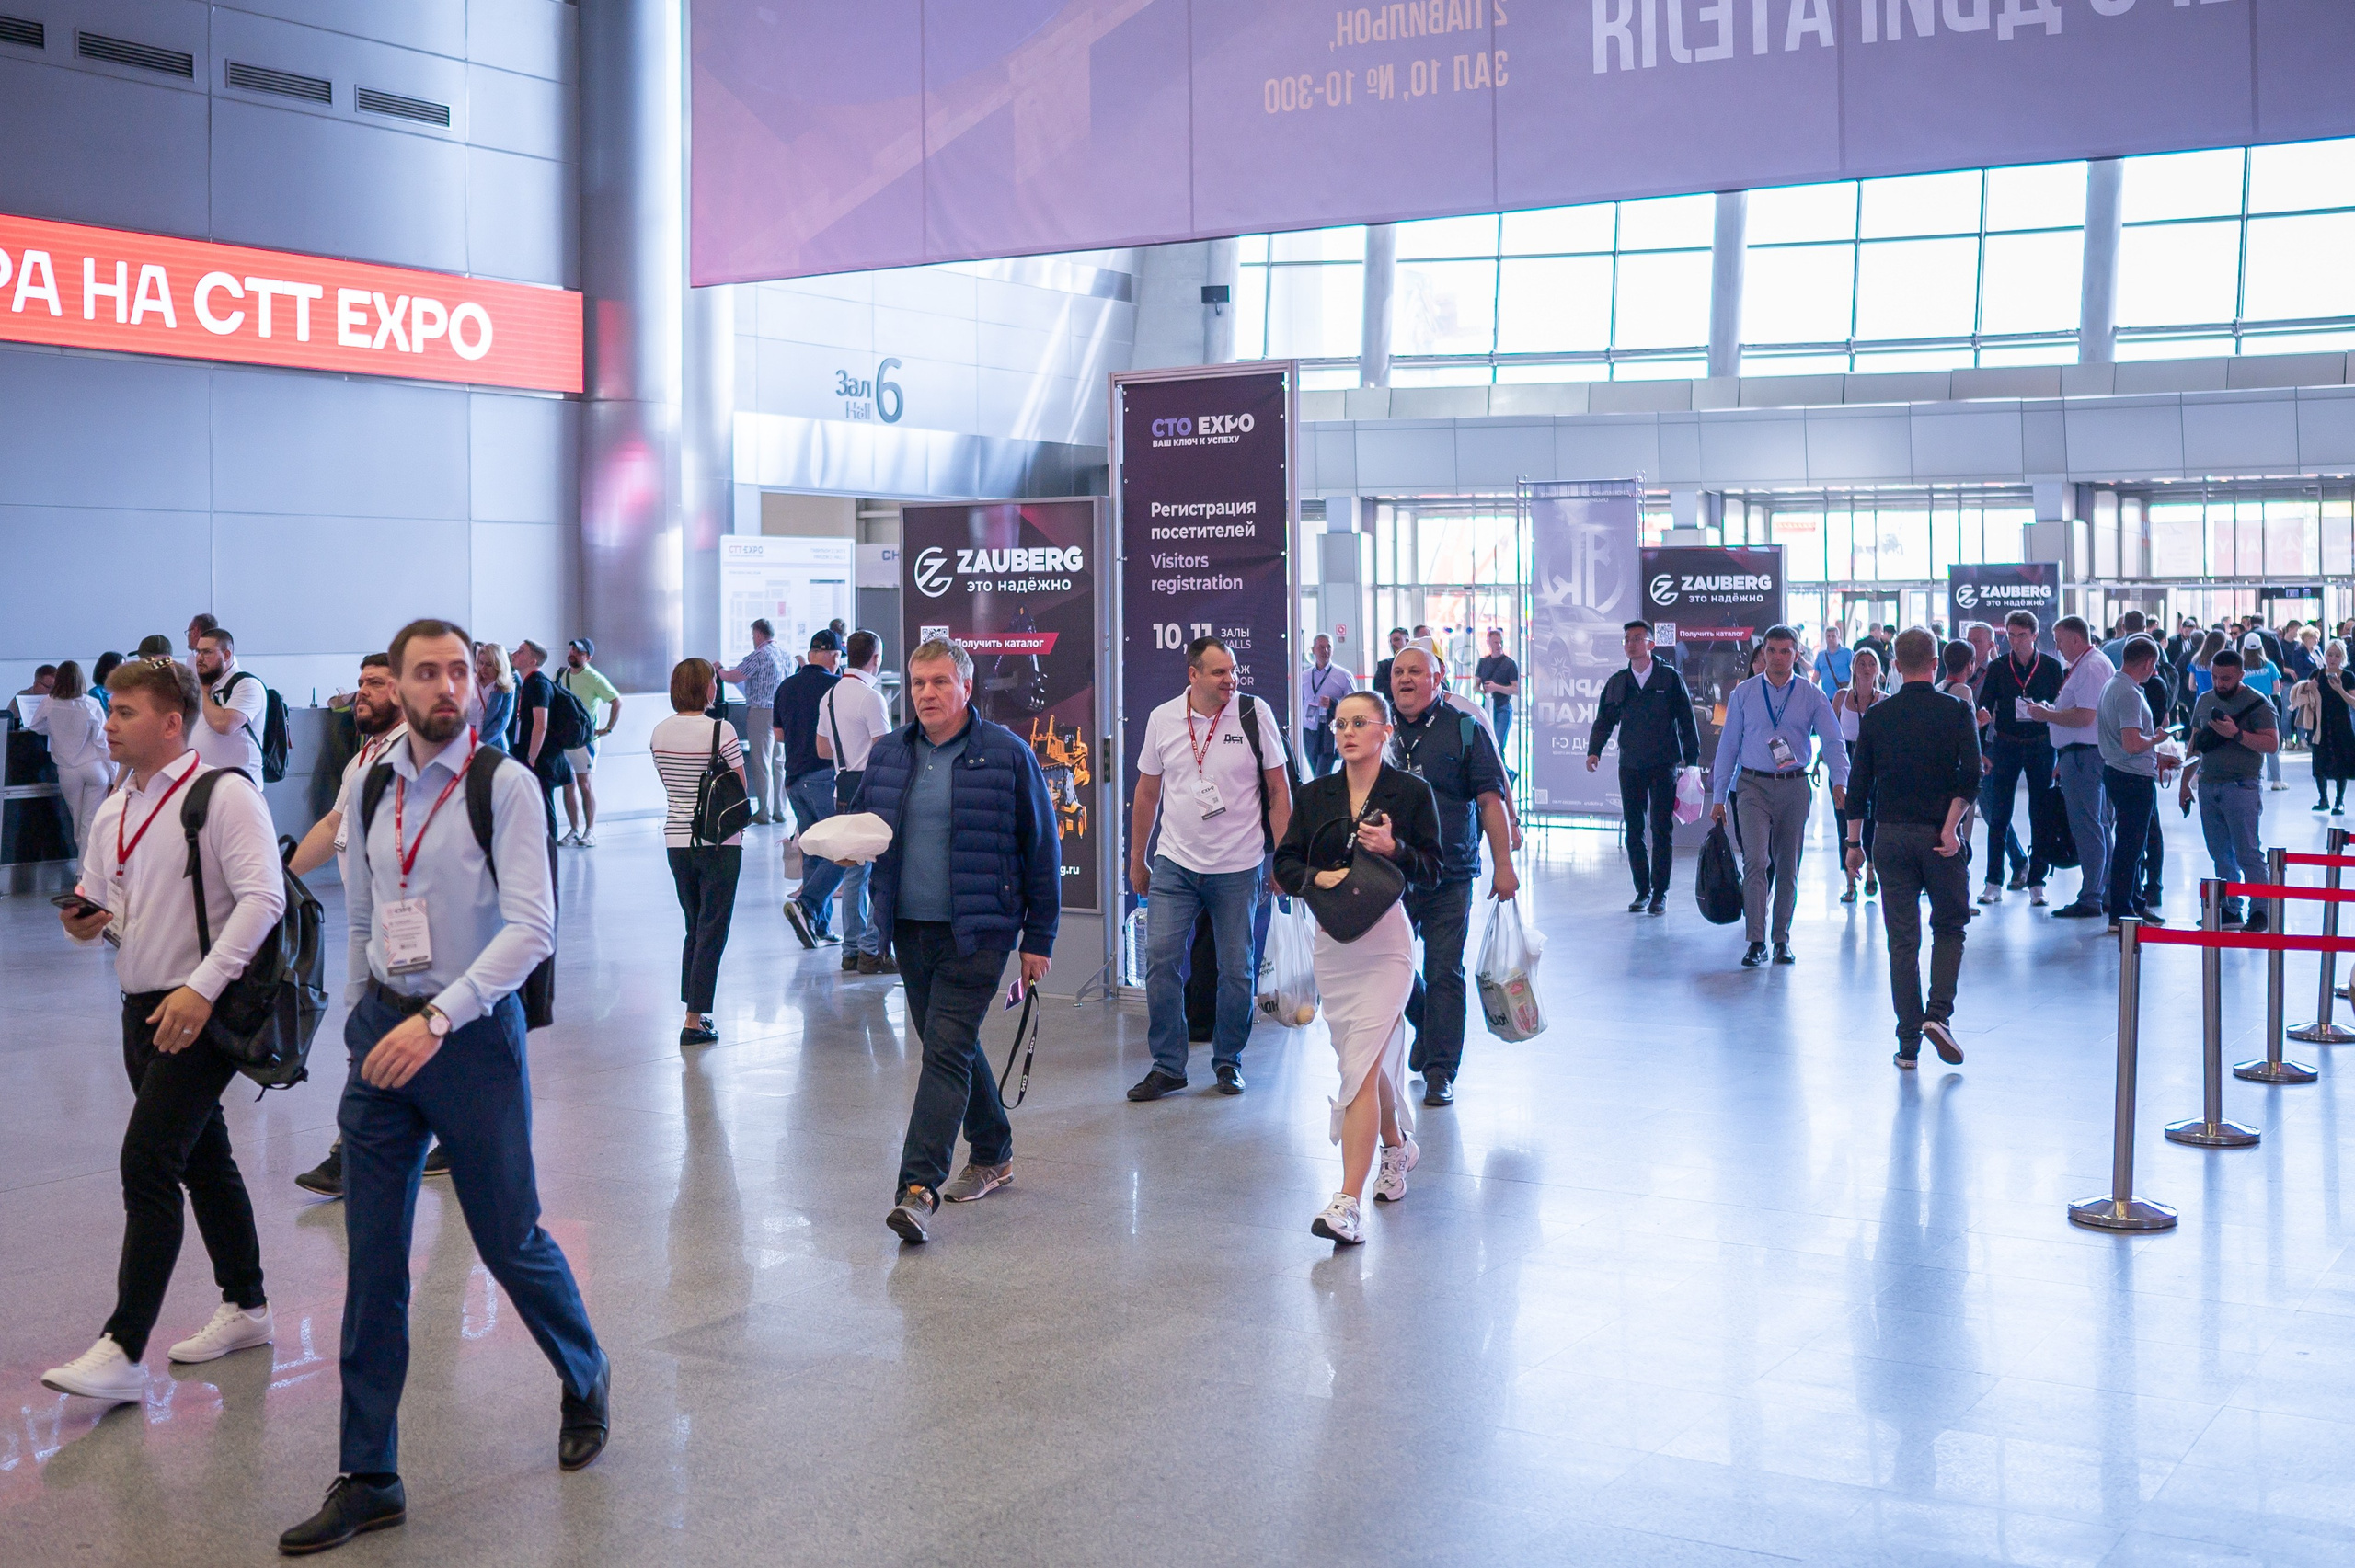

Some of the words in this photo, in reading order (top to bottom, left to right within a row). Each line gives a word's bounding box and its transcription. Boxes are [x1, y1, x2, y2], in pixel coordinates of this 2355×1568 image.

[83, 257, 177, 328] НА
[193, 270, 324, 342] CTT
[337, 287, 493, 361] EXPO
[835, 369, 872, 399] Зал
[876, 357, 904, 424] 6
[845, 400, 872, 420] Hall
[1198, 413, 1255, 435] EXPO
[1152, 439, 1172, 448] ВАШ
[1173, 437, 1197, 447] КЛЮЧ
[1199, 437, 1206, 445] К
[1207, 435, 1240, 445] УСПЕХУ
[1151, 501, 1257, 520] Регистрация
[1151, 521, 1256, 540] посетителей
[956, 545, 1084, 573] ZAUBERG
[1150, 552, 1210, 569] Visitors
[967, 581, 993, 592] это
[997, 577, 1072, 594] надёжно
[1151, 573, 1244, 595] registration
[1681, 575, 1773, 591] ZAUBERG
[1980, 584, 2051, 598] ZAUBERG
[1688, 594, 1707, 603] это
[1710, 592, 1764, 604] надёжно
[2004, 598, 2045, 608] надёжно
[1220, 628, 1250, 638] ЗАЛЫ
[1679, 630, 1715, 639] Получить
[1716, 630, 1745, 638] каталог
[954, 637, 1003, 652] Получить
[1004, 638, 1045, 648] каталог
[1225, 639, 1252, 649] ALLS
